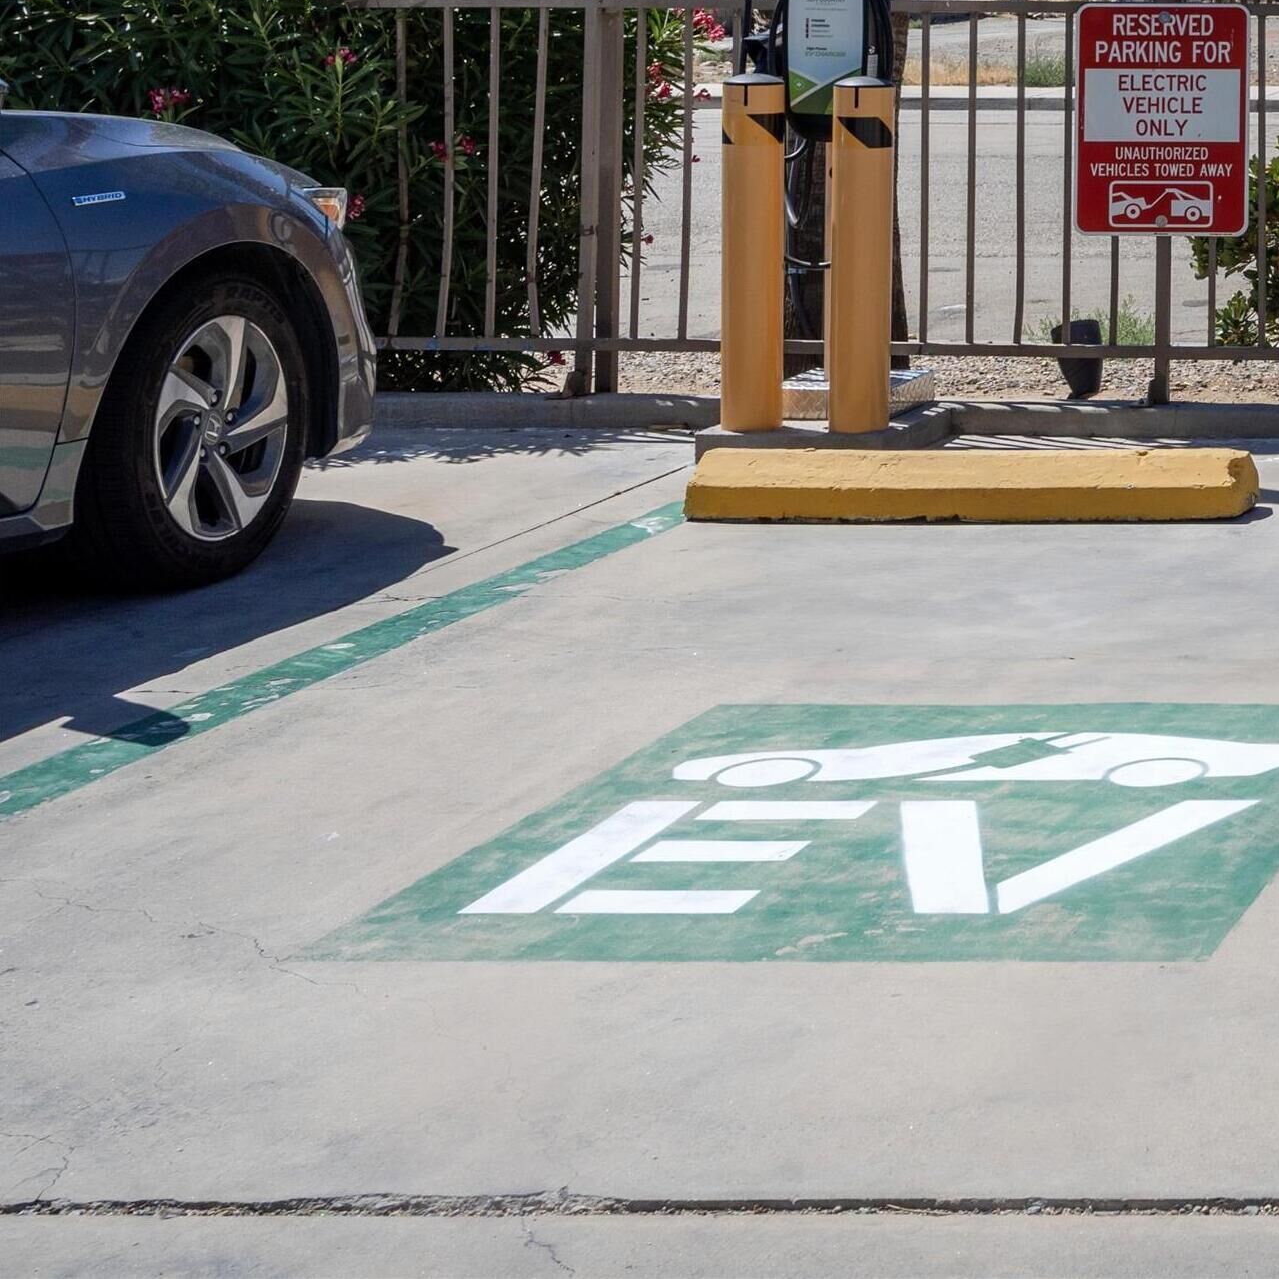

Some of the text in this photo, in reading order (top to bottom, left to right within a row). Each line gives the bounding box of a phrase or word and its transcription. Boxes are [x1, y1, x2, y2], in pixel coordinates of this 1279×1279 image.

[1112, 14, 1214, 36] RESERVED
[1095, 41, 1231, 63] PARKING FOR
[1118, 74, 1207, 91] ELECTRIC
[1123, 97, 1203, 114] VEHICLE
[1135, 119, 1188, 136] ONLY
[1115, 147, 1208, 160] UNAUTHORIZED
[1090, 164, 1233, 177] VEHICLES TOWED AWAY
[457, 799, 1263, 916] EV
